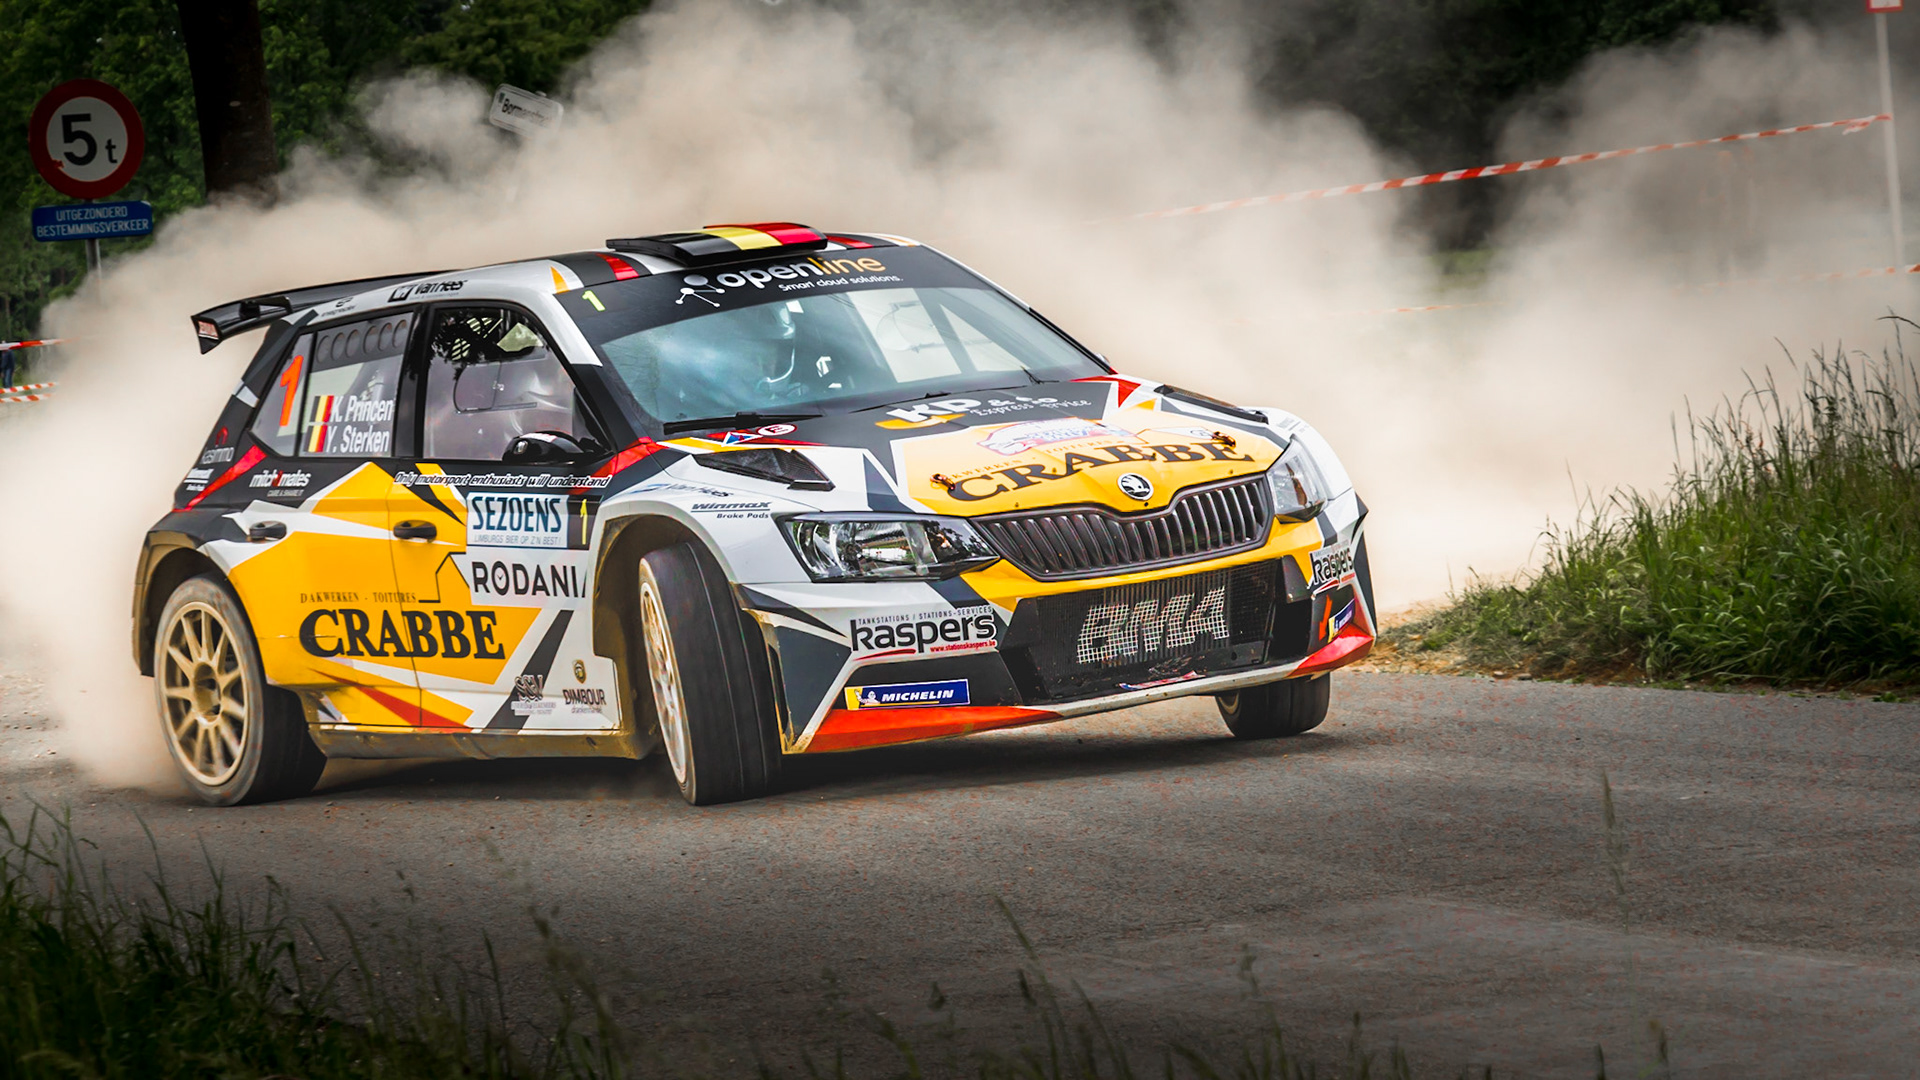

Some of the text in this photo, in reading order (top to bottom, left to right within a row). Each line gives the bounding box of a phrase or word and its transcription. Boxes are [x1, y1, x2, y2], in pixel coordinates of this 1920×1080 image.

[62, 113, 117, 166] 5 t
[56, 206, 128, 222] UITGEZONDERD
[37, 219, 149, 238] BESTEMMINGSVERKEER
[716, 257, 886, 289] openline
[817, 277, 849, 287] cloud
[582, 290, 606, 311] 1
[280, 355, 304, 427] 1
[330, 395, 394, 423] K. Princen
[886, 398, 983, 422] KP
[326, 425, 390, 453] Y. Sterken
[417, 474, 471, 487] motorsport
[470, 474, 526, 486] enthusiasts
[527, 474, 550, 487] will
[548, 474, 612, 488] understand
[946, 442, 1256, 501] CRABBE
[472, 496, 562, 532] SEZOENS
[692, 502, 772, 510] Winmax
[580, 499, 588, 545] 1
[474, 534, 504, 544] LIMBURGS
[505, 535, 519, 544] BIER
[520, 535, 529, 545] OP
[300, 592, 359, 604] DAKWERKEN
[373, 592, 417, 603] TOITURES
[858, 614, 910, 626] TANKSTATIONS
[1077, 586, 1230, 664] BMA
[299, 608, 506, 660] CRABBE
[850, 614, 996, 654] kaspers
[930, 640, 997, 653] www.stationskaspers.be
[563, 688, 607, 705] DIMBOUR
[881, 689, 955, 702] MICHELIN
